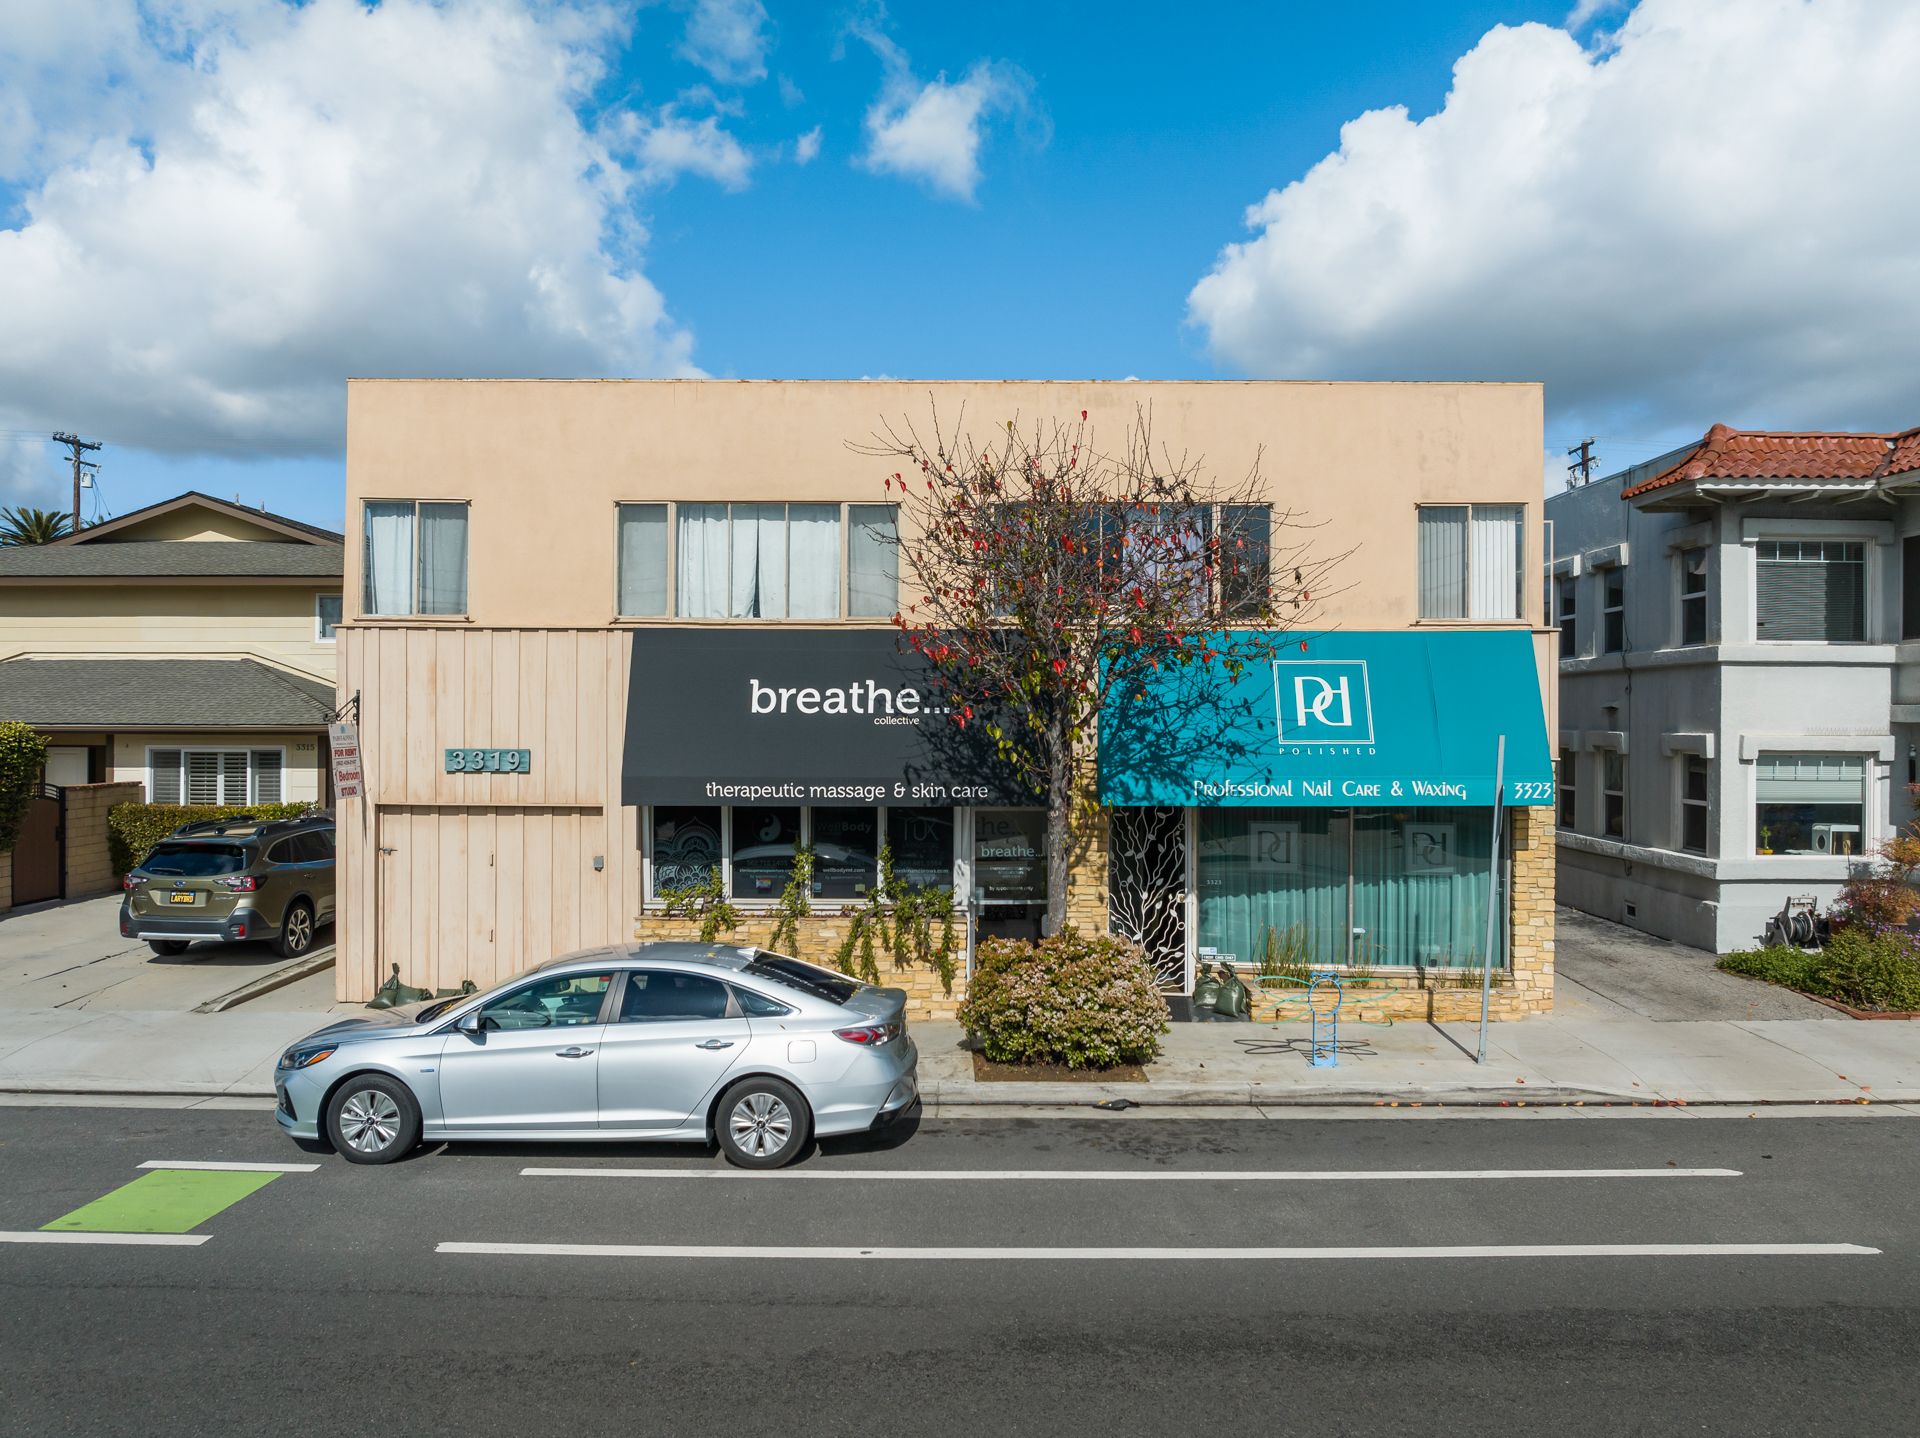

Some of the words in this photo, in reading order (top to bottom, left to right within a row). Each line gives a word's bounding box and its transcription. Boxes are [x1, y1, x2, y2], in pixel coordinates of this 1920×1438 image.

[873, 716, 920, 725] collective
[334, 749, 344, 757] FOR
[344, 748, 357, 757] RENT
[1279, 747, 1376, 756] POLISHED
[453, 751, 520, 770] 3319
[338, 771, 360, 782] Bedroom
[341, 786, 357, 796] STUDIO
[705, 782, 805, 801] therapeutic
[810, 786, 886, 802] massage
[893, 783, 906, 798] &
[912, 783, 946, 798] skin
[951, 785, 989, 798] care
[1390, 781, 1403, 797] &
[1514, 782, 1552, 799] 3323
